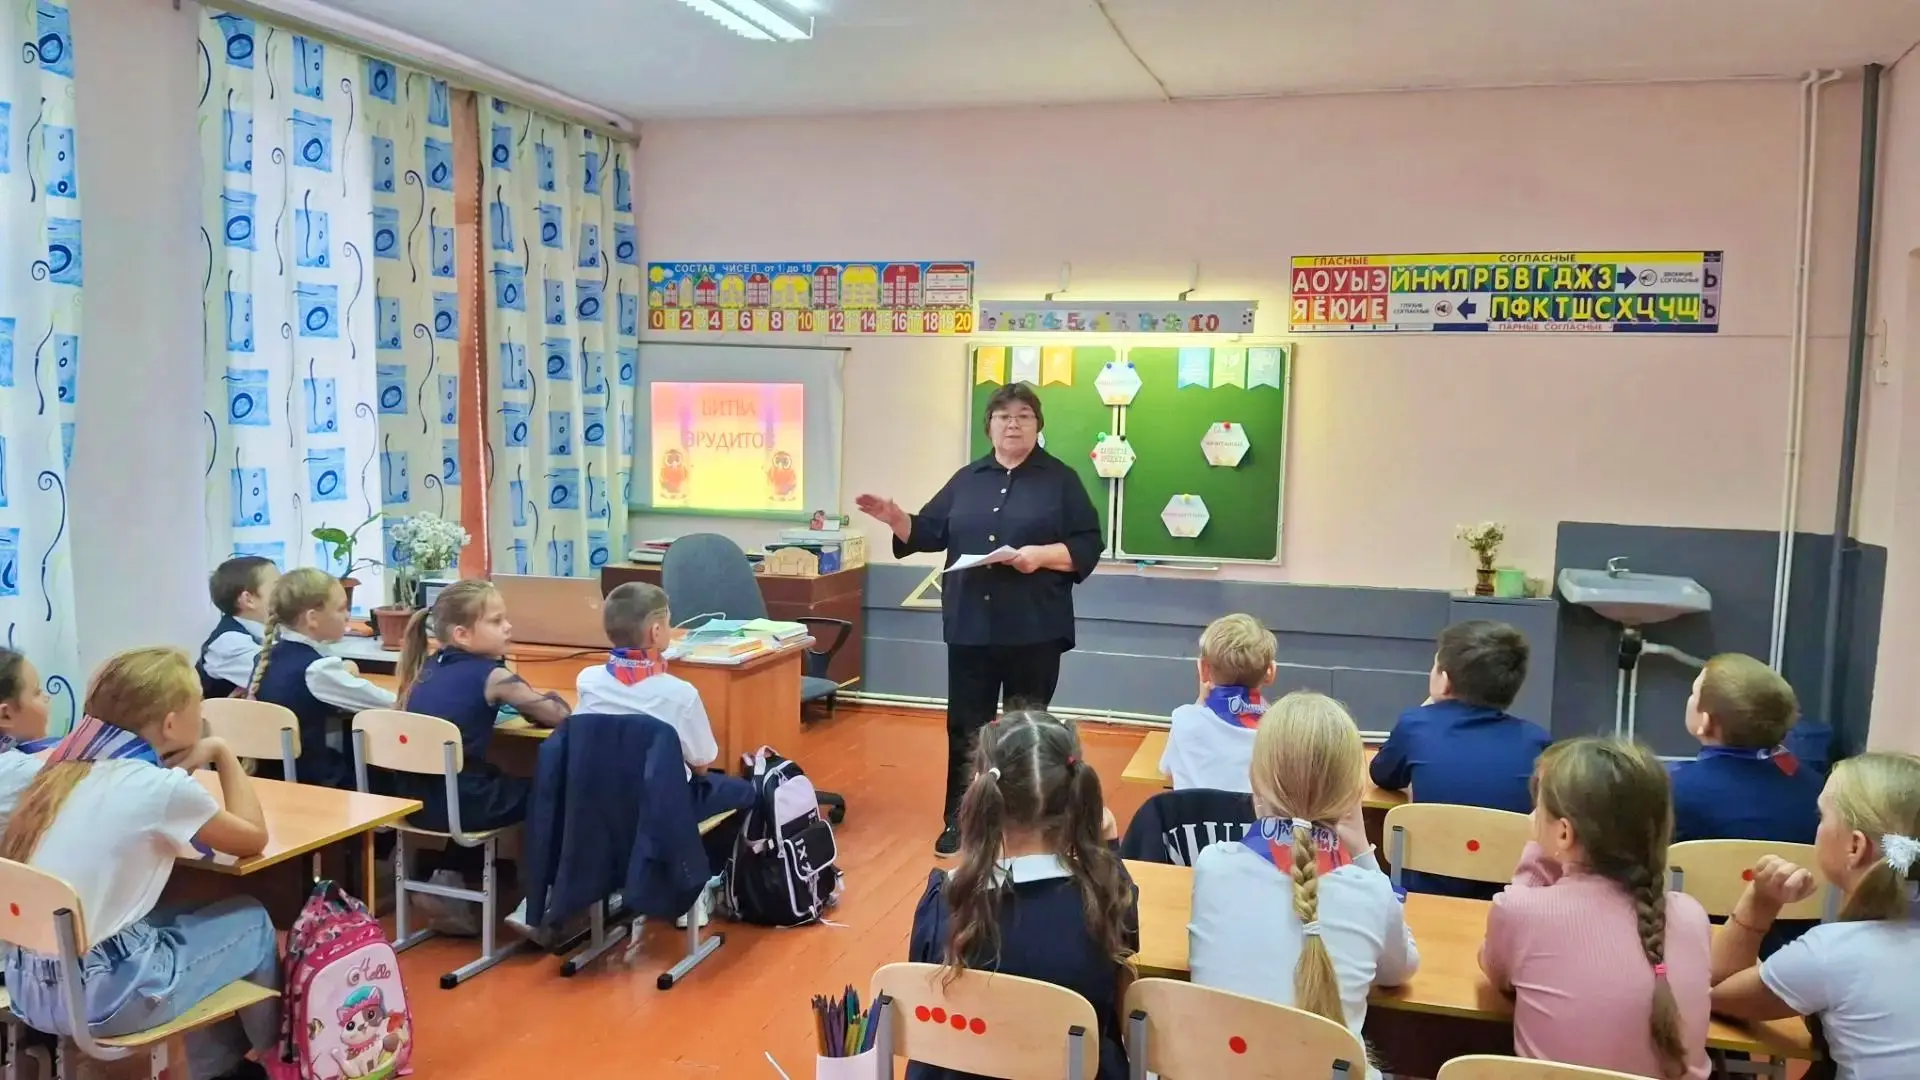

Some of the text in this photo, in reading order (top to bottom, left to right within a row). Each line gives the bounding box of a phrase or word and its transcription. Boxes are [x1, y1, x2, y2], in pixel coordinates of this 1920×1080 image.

[1313, 256, 1369, 266] ГЛАСНЫЕ
[1498, 253, 1577, 263] СОГЛАСНЫЕ
[674, 263, 716, 273] СОСТАВ
[721, 263, 757, 273] ЧИСЕЛ
[786, 265, 799, 274] до
[653, 312, 663, 328] 0
[681, 312, 693, 328] 2
[709, 311, 721, 329] 4
[740, 312, 752, 329] 6
[771, 312, 782, 330] 8
[799, 312, 813, 330] 10
[829, 313, 844, 331] 12
[861, 313, 877, 331] 14
[892, 313, 907, 331] 16
[923, 313, 938, 331] 18
[956, 313, 972, 331] 20
[1067, 312, 1081, 331] 5
[1190, 313, 1220, 332] 10
[1498, 323, 1604, 331] ПАРНЫЕ СОГЛАСНЫЕ
[684, 431, 774, 453] ЭРУДИТО
[352, 956, 392, 983] Hello
